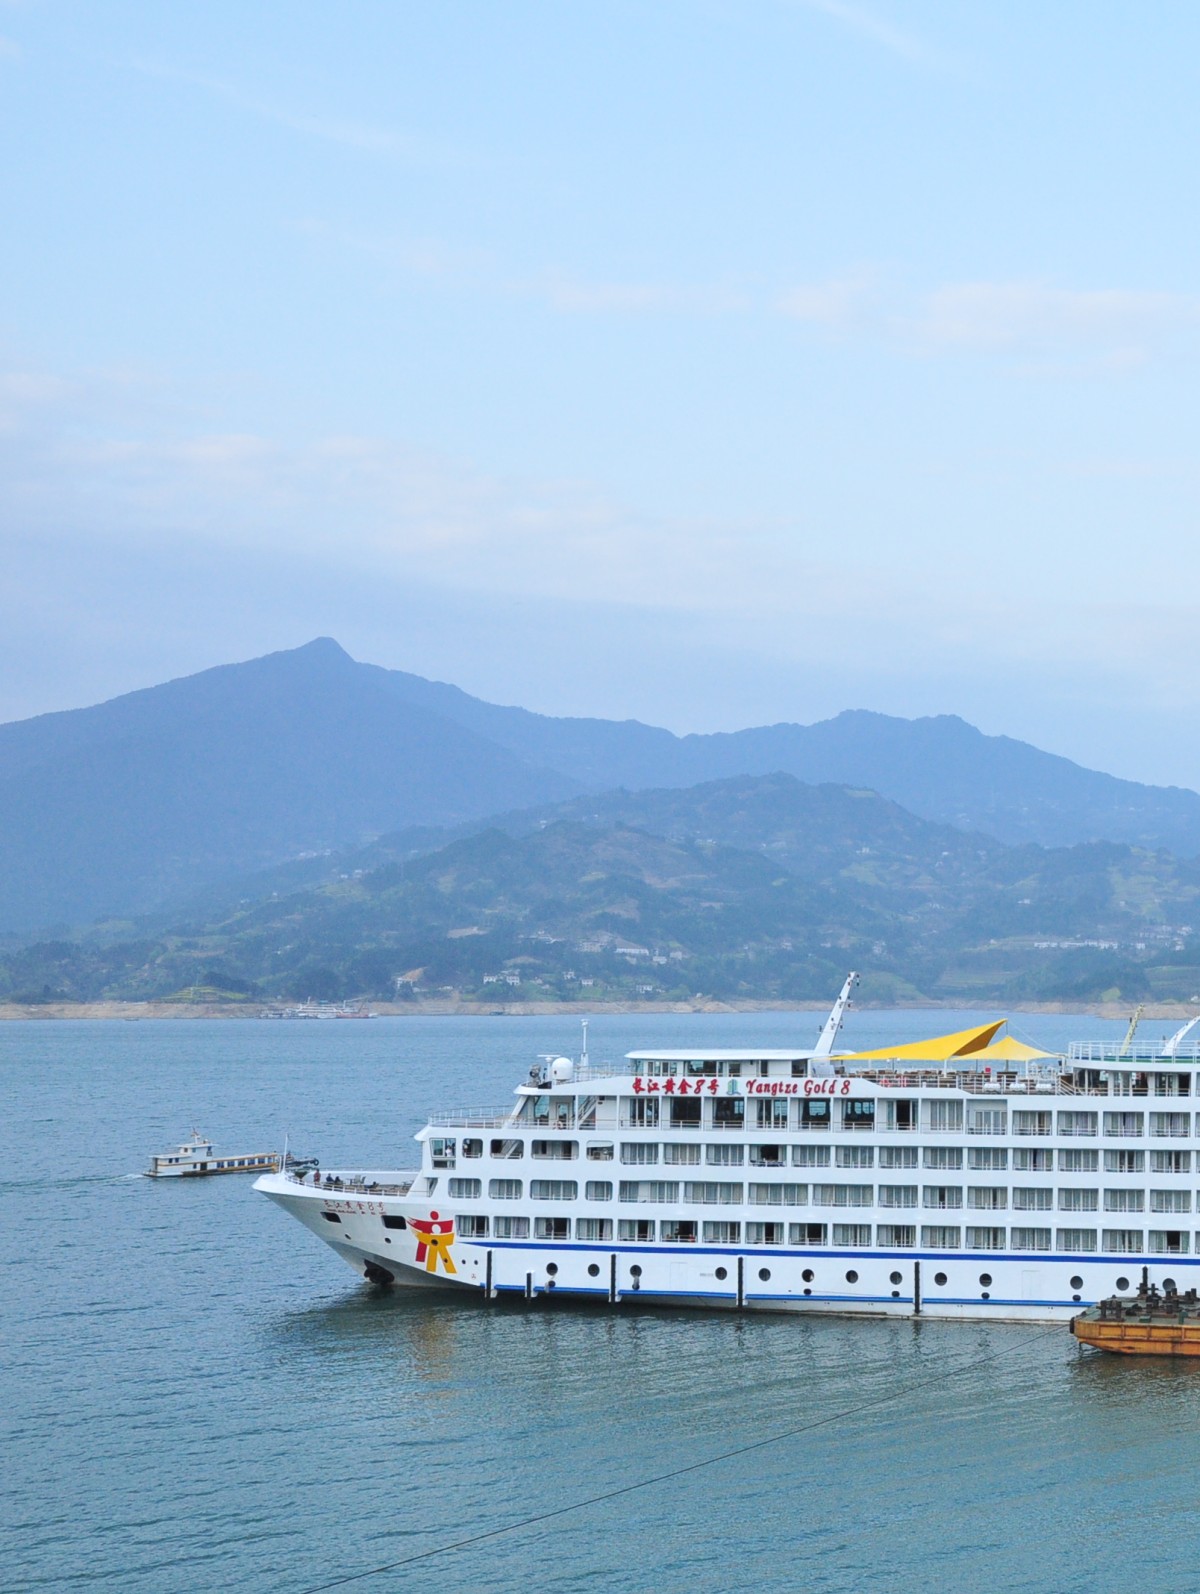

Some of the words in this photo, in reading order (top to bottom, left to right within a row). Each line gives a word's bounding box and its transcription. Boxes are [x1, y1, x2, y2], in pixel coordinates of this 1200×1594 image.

[632, 1077, 719, 1095] 长江黄金8号
[746, 1080, 798, 1096] Yangtze
[804, 1080, 836, 1096] Gold
[840, 1080, 851, 1095] 8
